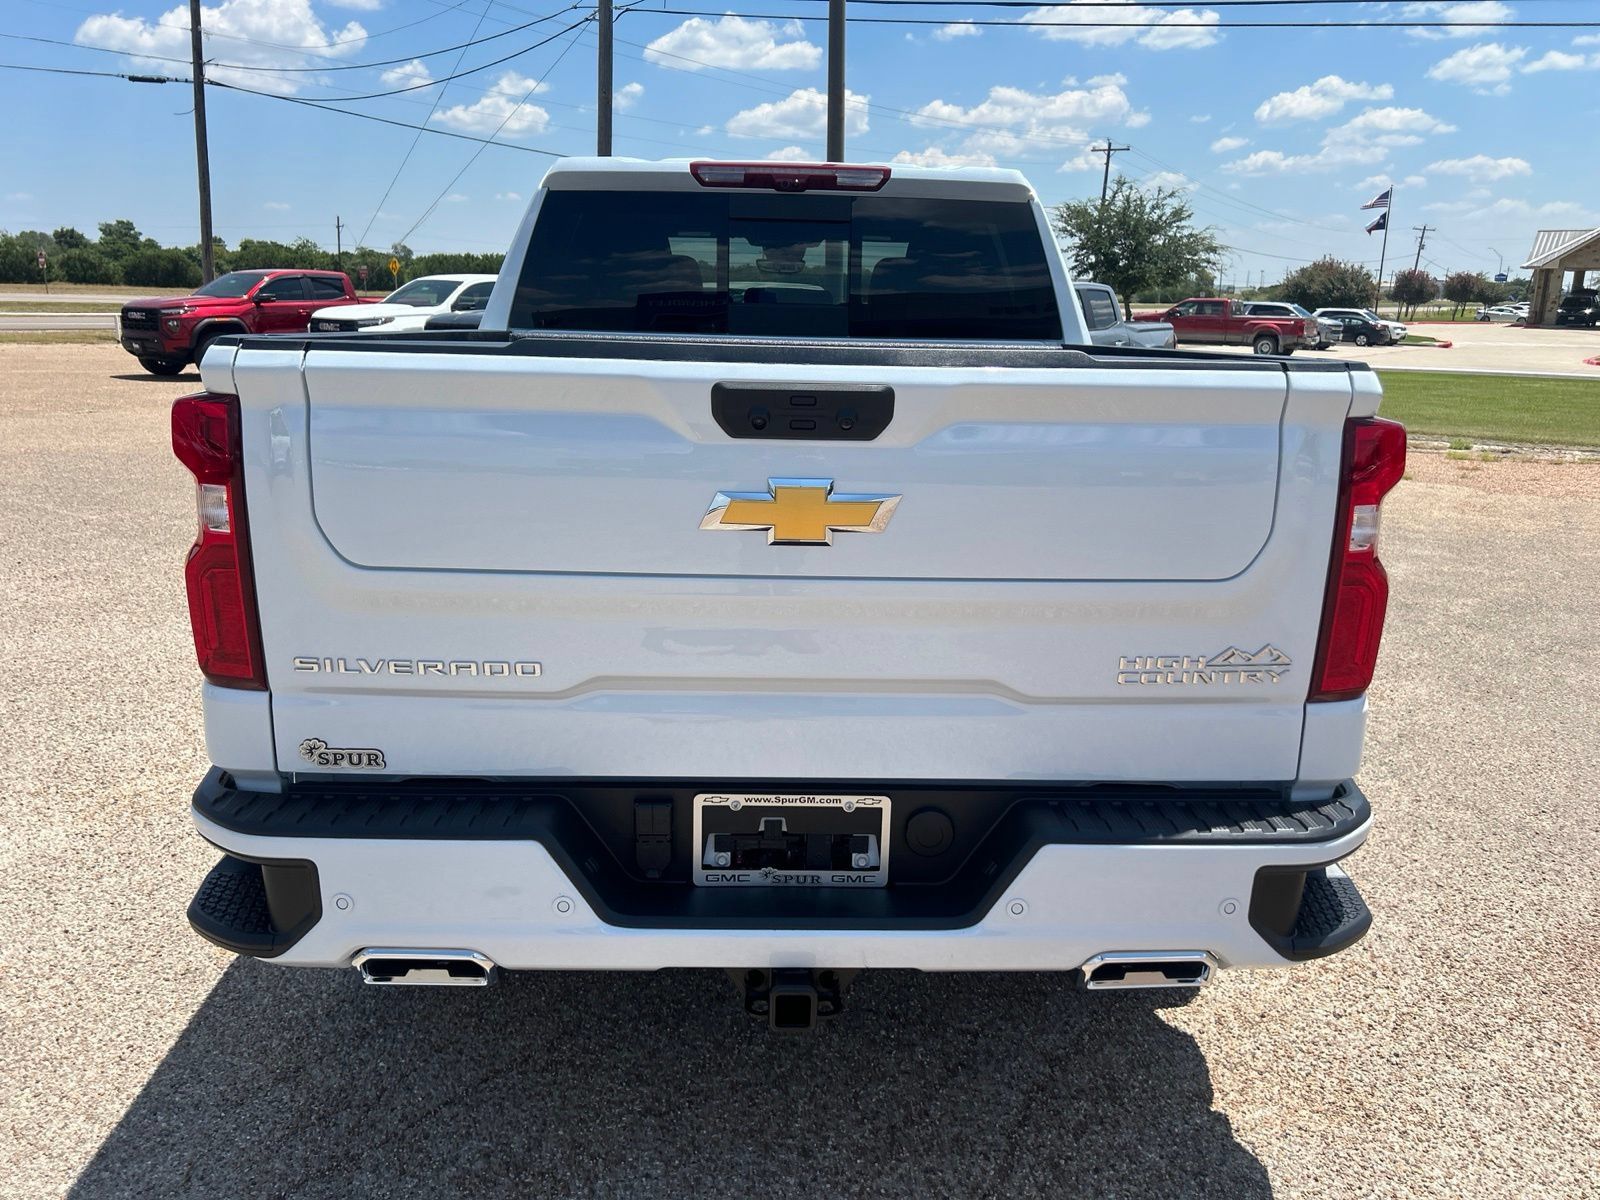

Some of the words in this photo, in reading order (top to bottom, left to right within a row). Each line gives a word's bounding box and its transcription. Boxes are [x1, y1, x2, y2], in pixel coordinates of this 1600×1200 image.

[293, 656, 543, 677] SILVERADO
[1119, 655, 1207, 669] HIGH
[1117, 669, 1290, 684] COUNTRY
[317, 751, 383, 767] SPUR
[744, 796, 842, 805] www.SpurGM.com
[705, 874, 751, 882] GMC
[772, 875, 823, 884] SPUR
[831, 875, 877, 883] GMC
